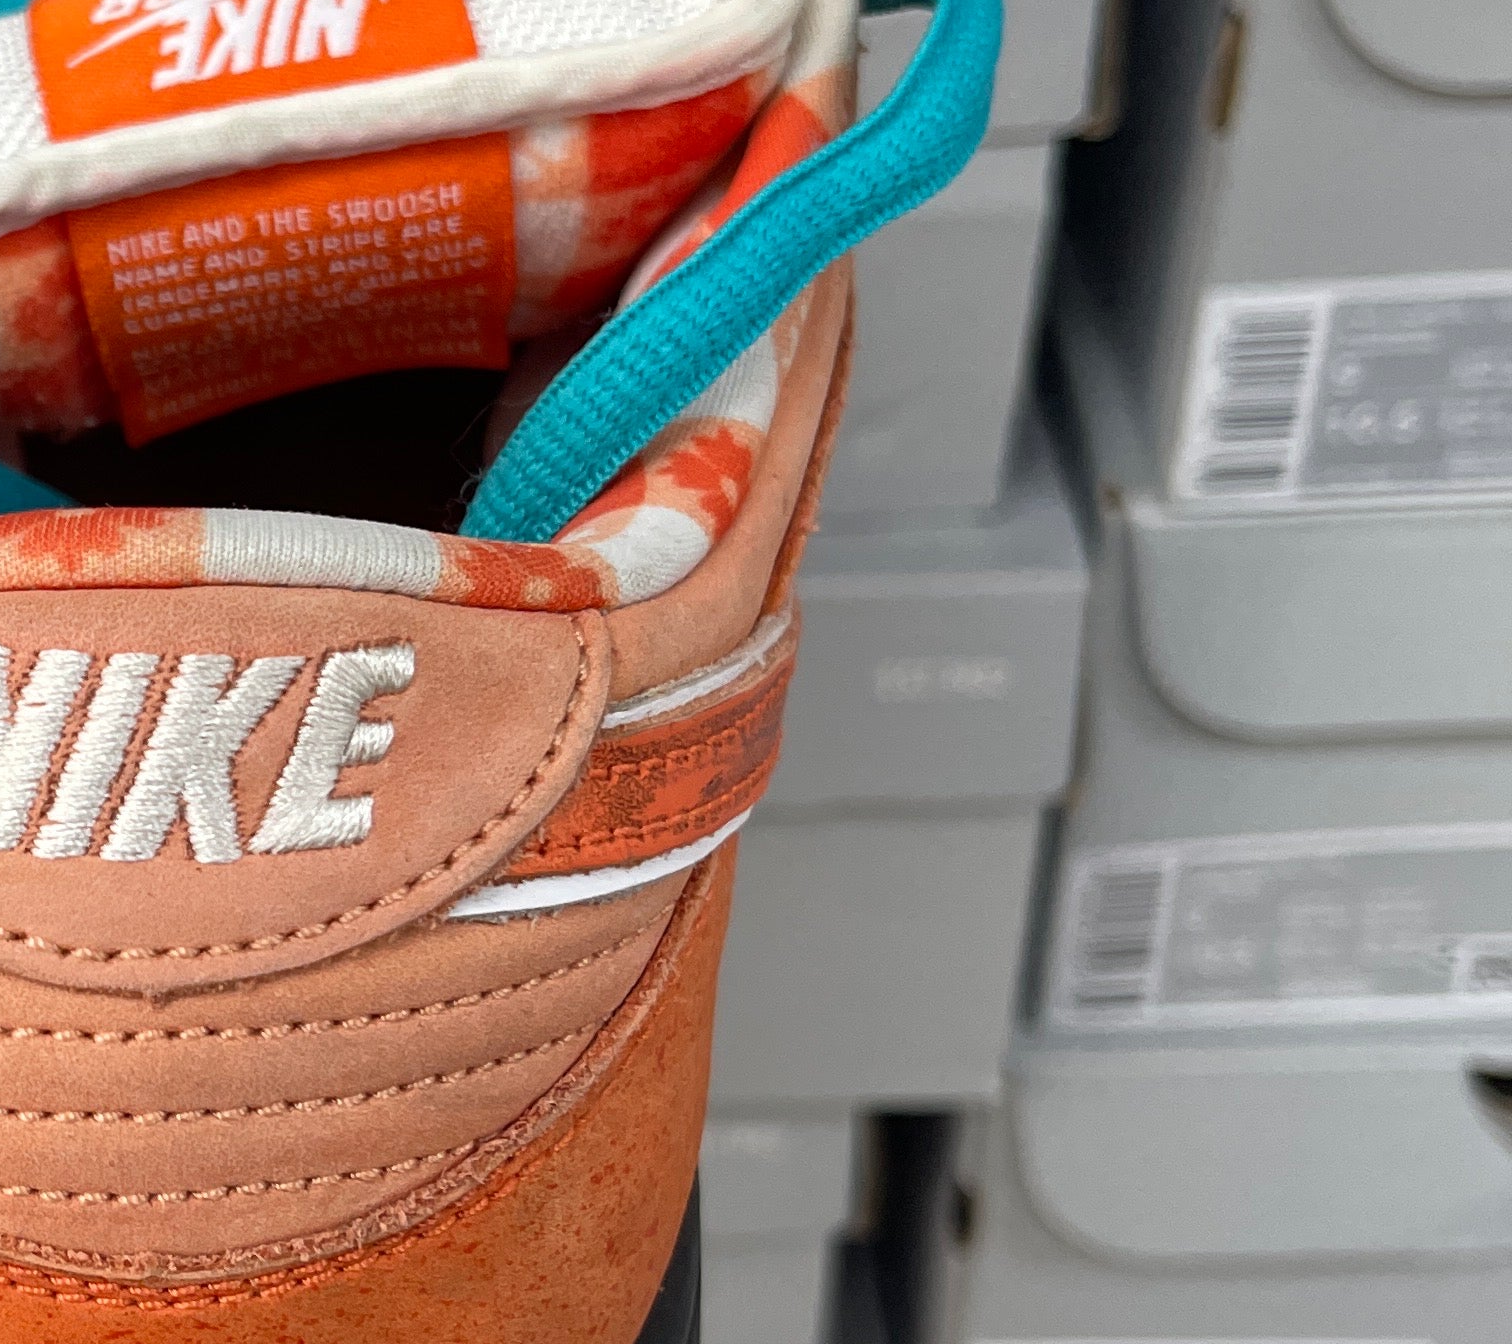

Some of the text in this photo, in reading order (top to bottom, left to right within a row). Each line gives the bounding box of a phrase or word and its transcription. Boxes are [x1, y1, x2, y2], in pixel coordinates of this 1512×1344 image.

[106, 182, 464, 267] NIKE AND THE SWOOSH
[112, 215, 464, 291] NAME AND STRIPE ARE
